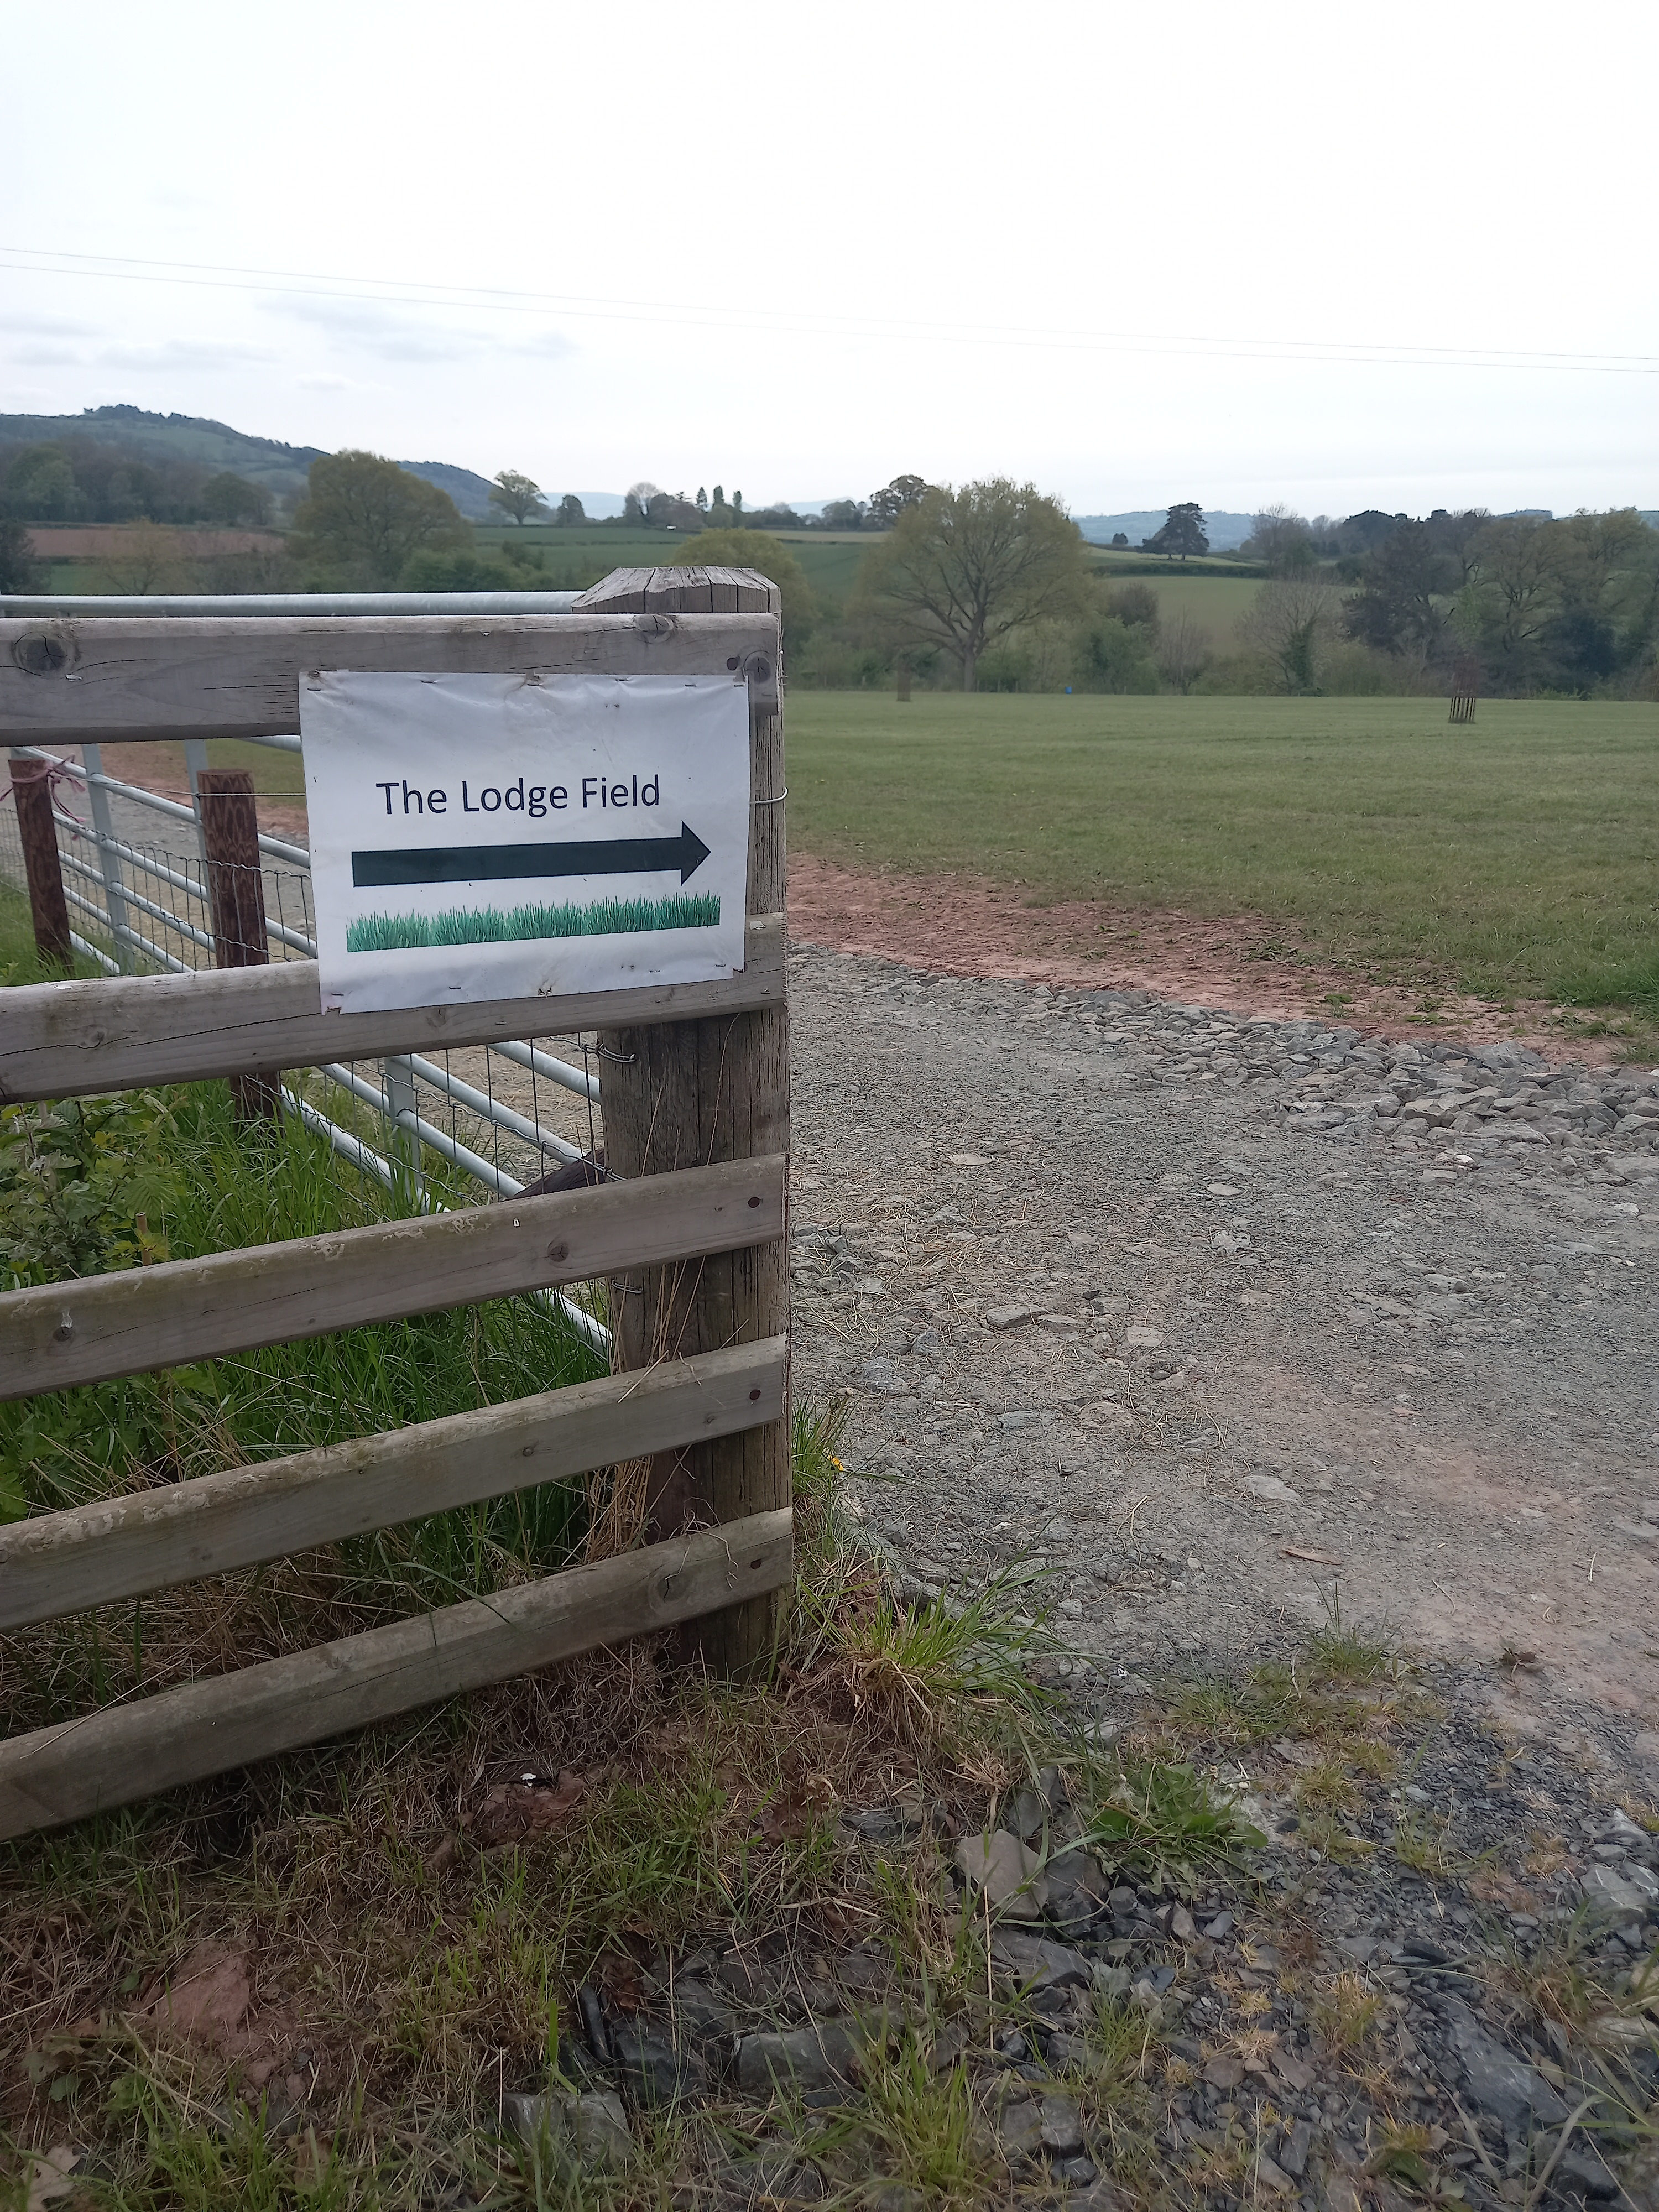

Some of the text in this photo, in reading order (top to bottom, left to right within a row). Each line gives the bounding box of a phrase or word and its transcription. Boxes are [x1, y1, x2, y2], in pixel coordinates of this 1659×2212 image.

[376, 774, 659, 817] The Lodge Field
